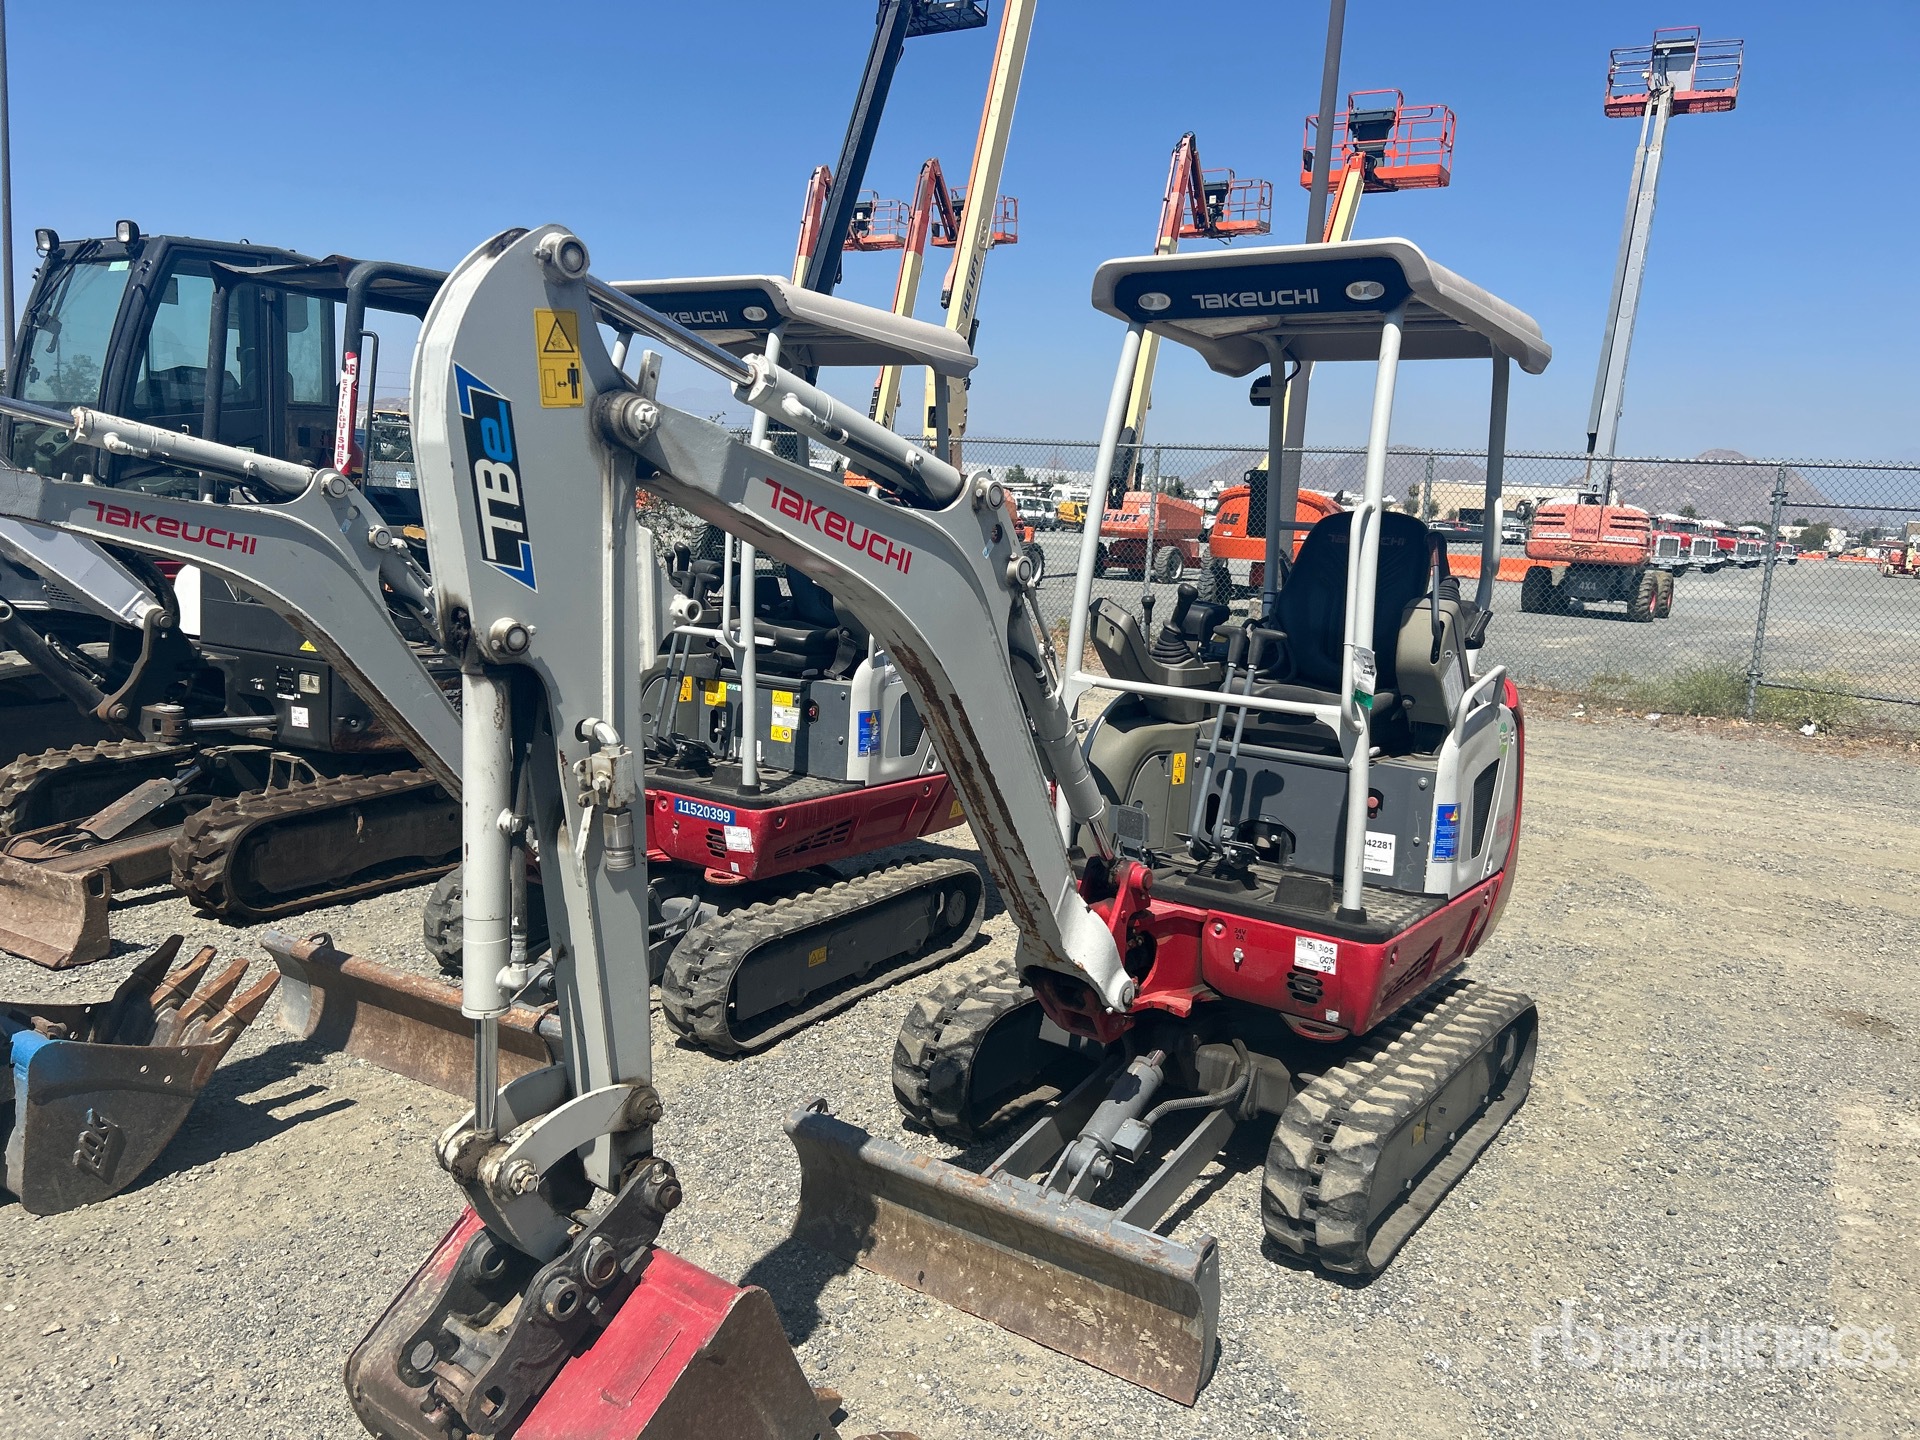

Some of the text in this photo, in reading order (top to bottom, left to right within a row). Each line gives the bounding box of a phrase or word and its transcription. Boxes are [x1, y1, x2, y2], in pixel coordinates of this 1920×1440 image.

[963, 253, 979, 319] JLG LIFT
[1191, 288, 1320, 310] TAKEUCHI
[87, 500, 257, 554] TAKEUCHI
[765, 477, 913, 574] TAKEUCHI
[1113, 513, 1140, 522] LIFT
[1219, 512, 1241, 525] JLG
[678, 800, 731, 823] 11520399
